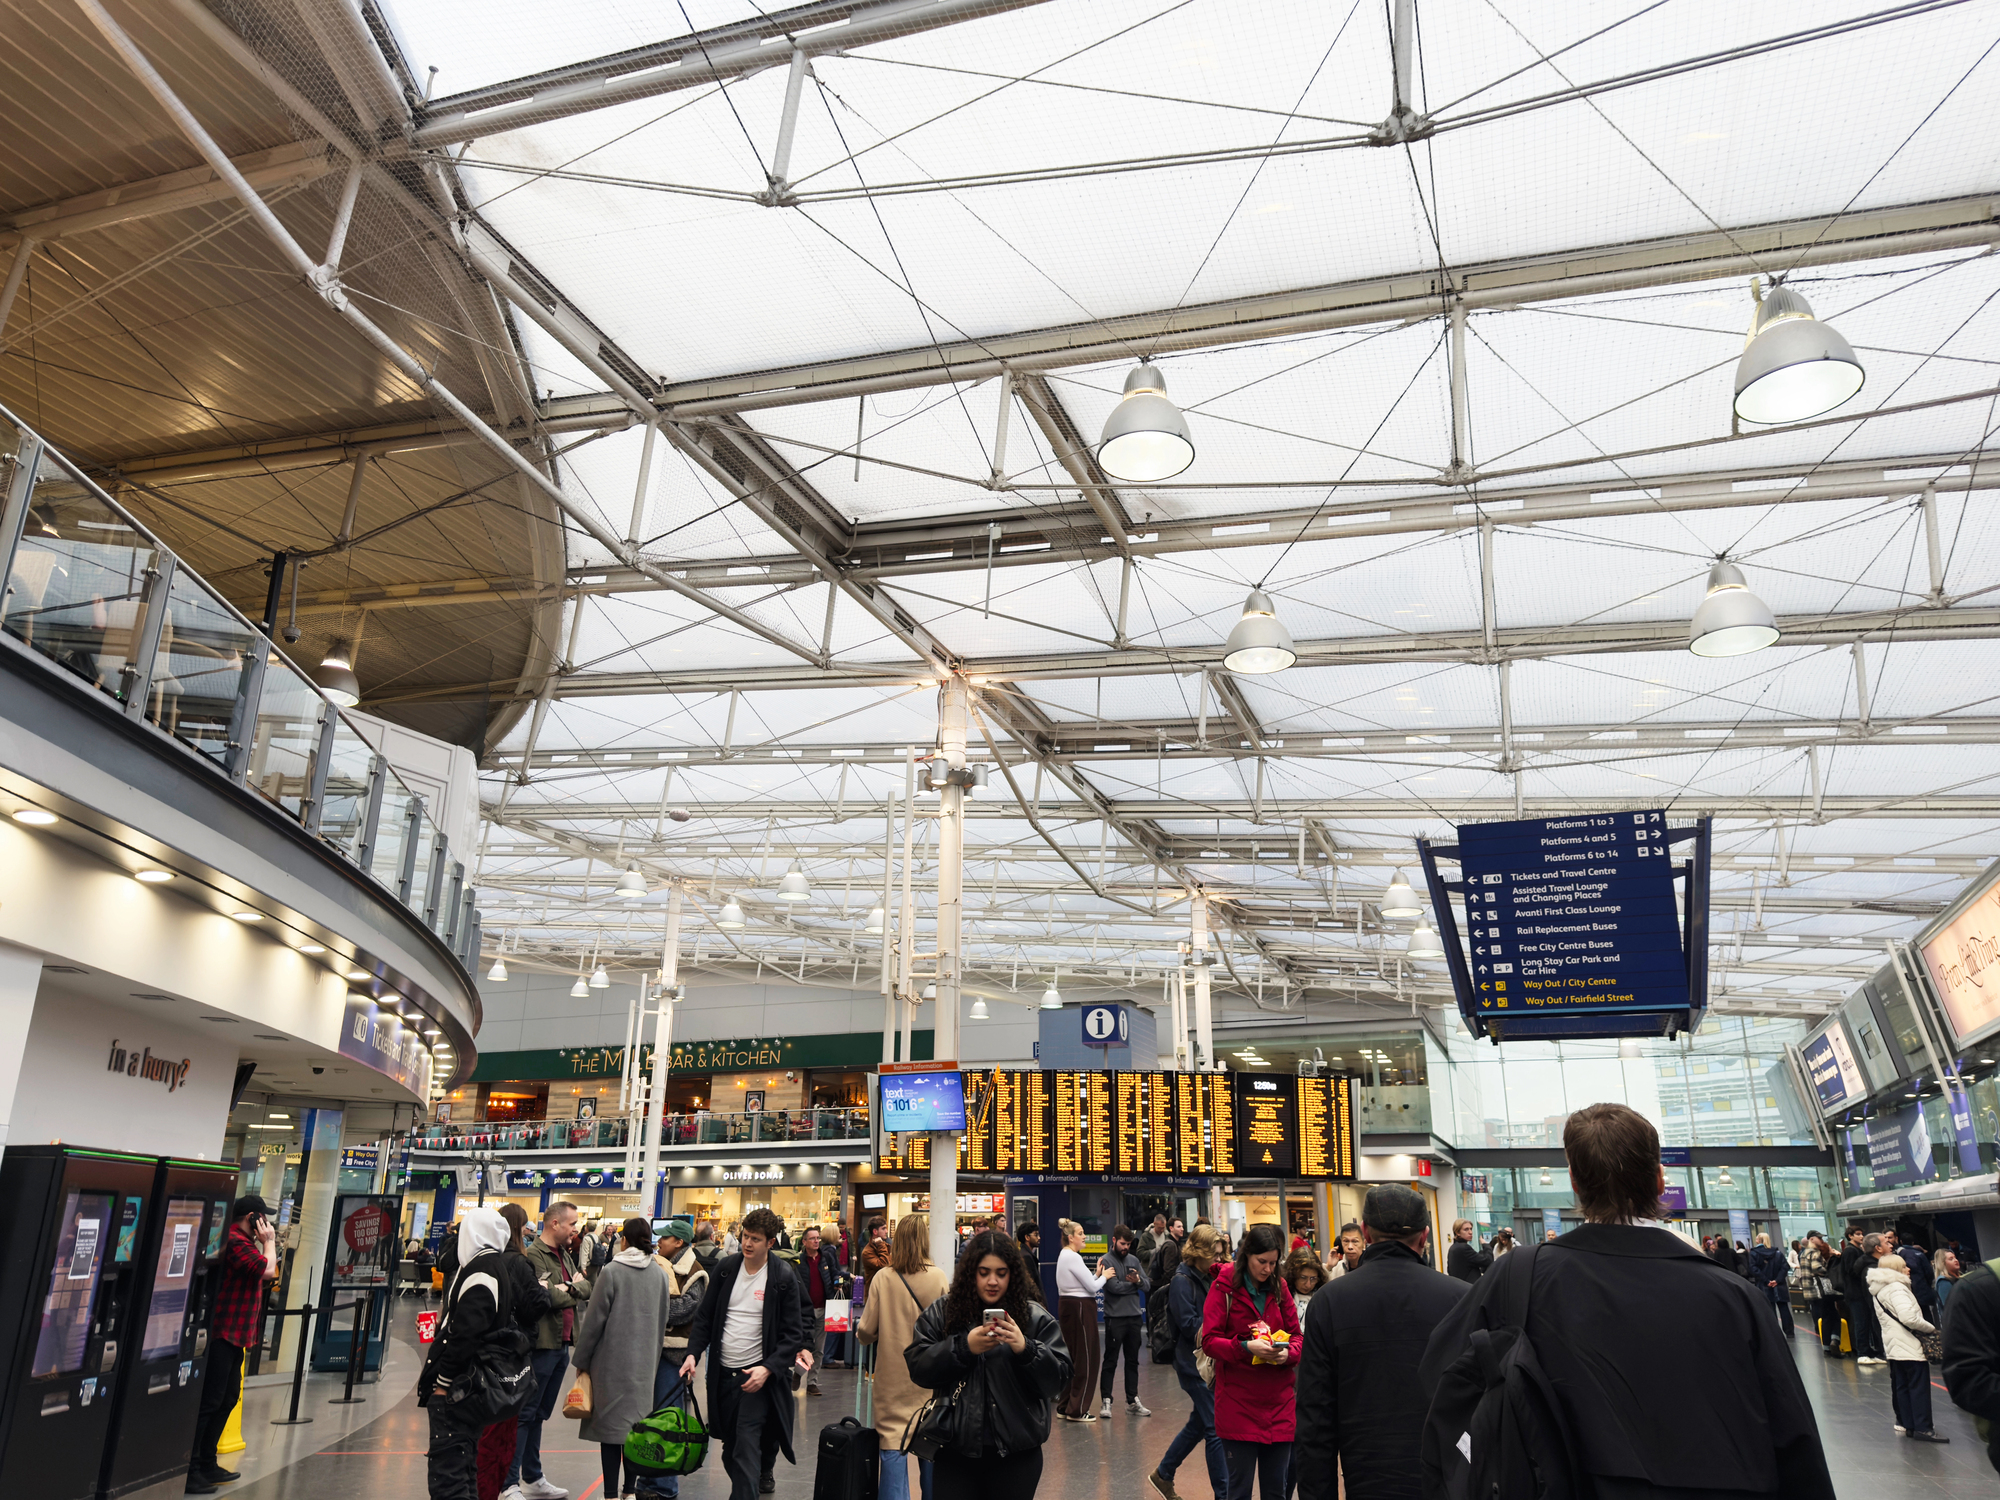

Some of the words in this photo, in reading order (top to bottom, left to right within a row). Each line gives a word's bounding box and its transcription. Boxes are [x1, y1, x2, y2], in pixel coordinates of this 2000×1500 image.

[1546, 819, 1588, 830] Platforms
[1597, 818, 1606, 826] to
[1608, 817, 1614, 825] 3
[1540, 835, 1583, 846] Platforms
[1583, 835, 1590, 843] 4
[1591, 833, 1608, 842] and
[1611, 833, 1616, 841] 5
[1544, 852, 1586, 863] Platforms
[1595, 851, 1605, 859] to
[1607, 850, 1618, 858] 14
[1510, 872, 1541, 882] Tickets
[1542, 870, 1558, 879] and
[1560, 868, 1586, 878] Travel
[1588, 867, 1617, 876] Centre
[1512, 885, 1547, 895] Assisted
[1548, 883, 1575, 893] Travel
[1576, 882, 1608, 893] Lounge
[1513, 894, 1530, 903] and
[1531, 893, 1573, 905] Changing
[1574, 891, 1602, 900] Places
[1515, 908, 1543, 918] Avanti
[1544, 907, 1566, 916] First
[1566, 906, 1588, 915] Class
[1589, 904, 1621, 915] Lounge
[1517, 926, 1533, 935] Rail
[1535, 923, 1591, 936] Replacement
[1592, 922, 1618, 931] Buses
[1519, 944, 1538, 952] Free
[1539, 943, 1556, 953] City
[1558, 941, 1587, 951] Centre
[1588, 940, 1614, 949] Buses
[1521, 958, 1543, 969] Long
[1544, 957, 1564, 968] Stay
[1565, 956, 1581, 965] Car
[1582, 955, 1602, 964] Park
[1603, 953, 1620, 962] and
[1522, 967, 1538, 976] Car
[1538, 966, 1557, 975] Hire
[1523, 980, 1544, 990] Way
[1545, 979, 1562, 988] Out
[1568, 978, 1586, 988] City
[1587, 977, 1617, 986] Centre
[1525, 996, 1547, 1006] Way
[1547, 995, 1563, 1004] Out
[1570, 994, 1606, 1003] Fairfield
[1606, 993, 1634, 1002] Street
[372, 1022, 393, 1057] Tickets
[108, 1039, 127, 1073] in
[127, 1052, 140, 1077] a
[140, 1047, 190, 1093] hurry?
[571, 1058, 599, 1073] THE
[604, 1048, 655, 1071] MLL
[667, 1054, 692, 1069] BAR
[697, 1053, 707, 1067] &
[711, 1050, 781, 1067] KITCHEN
[885, 1088, 904, 1098] text
[886, 1098, 917, 1111] 61016
[554, 1176, 581, 1185] pharmacy
[723, 1171, 753, 1180] OLIVER
[754, 1171, 784, 1180] BONAS
[1110, 1175, 1147, 1183] Information
[1174, 1177, 1199, 1185] Information
[355, 1217, 380, 1230] SAVINGS
[353, 1229, 366, 1239] TOO
[366, 1226, 379, 1237] GOO
[356, 1237, 365, 1247] TO
[365, 1235, 378, 1246] MIS
